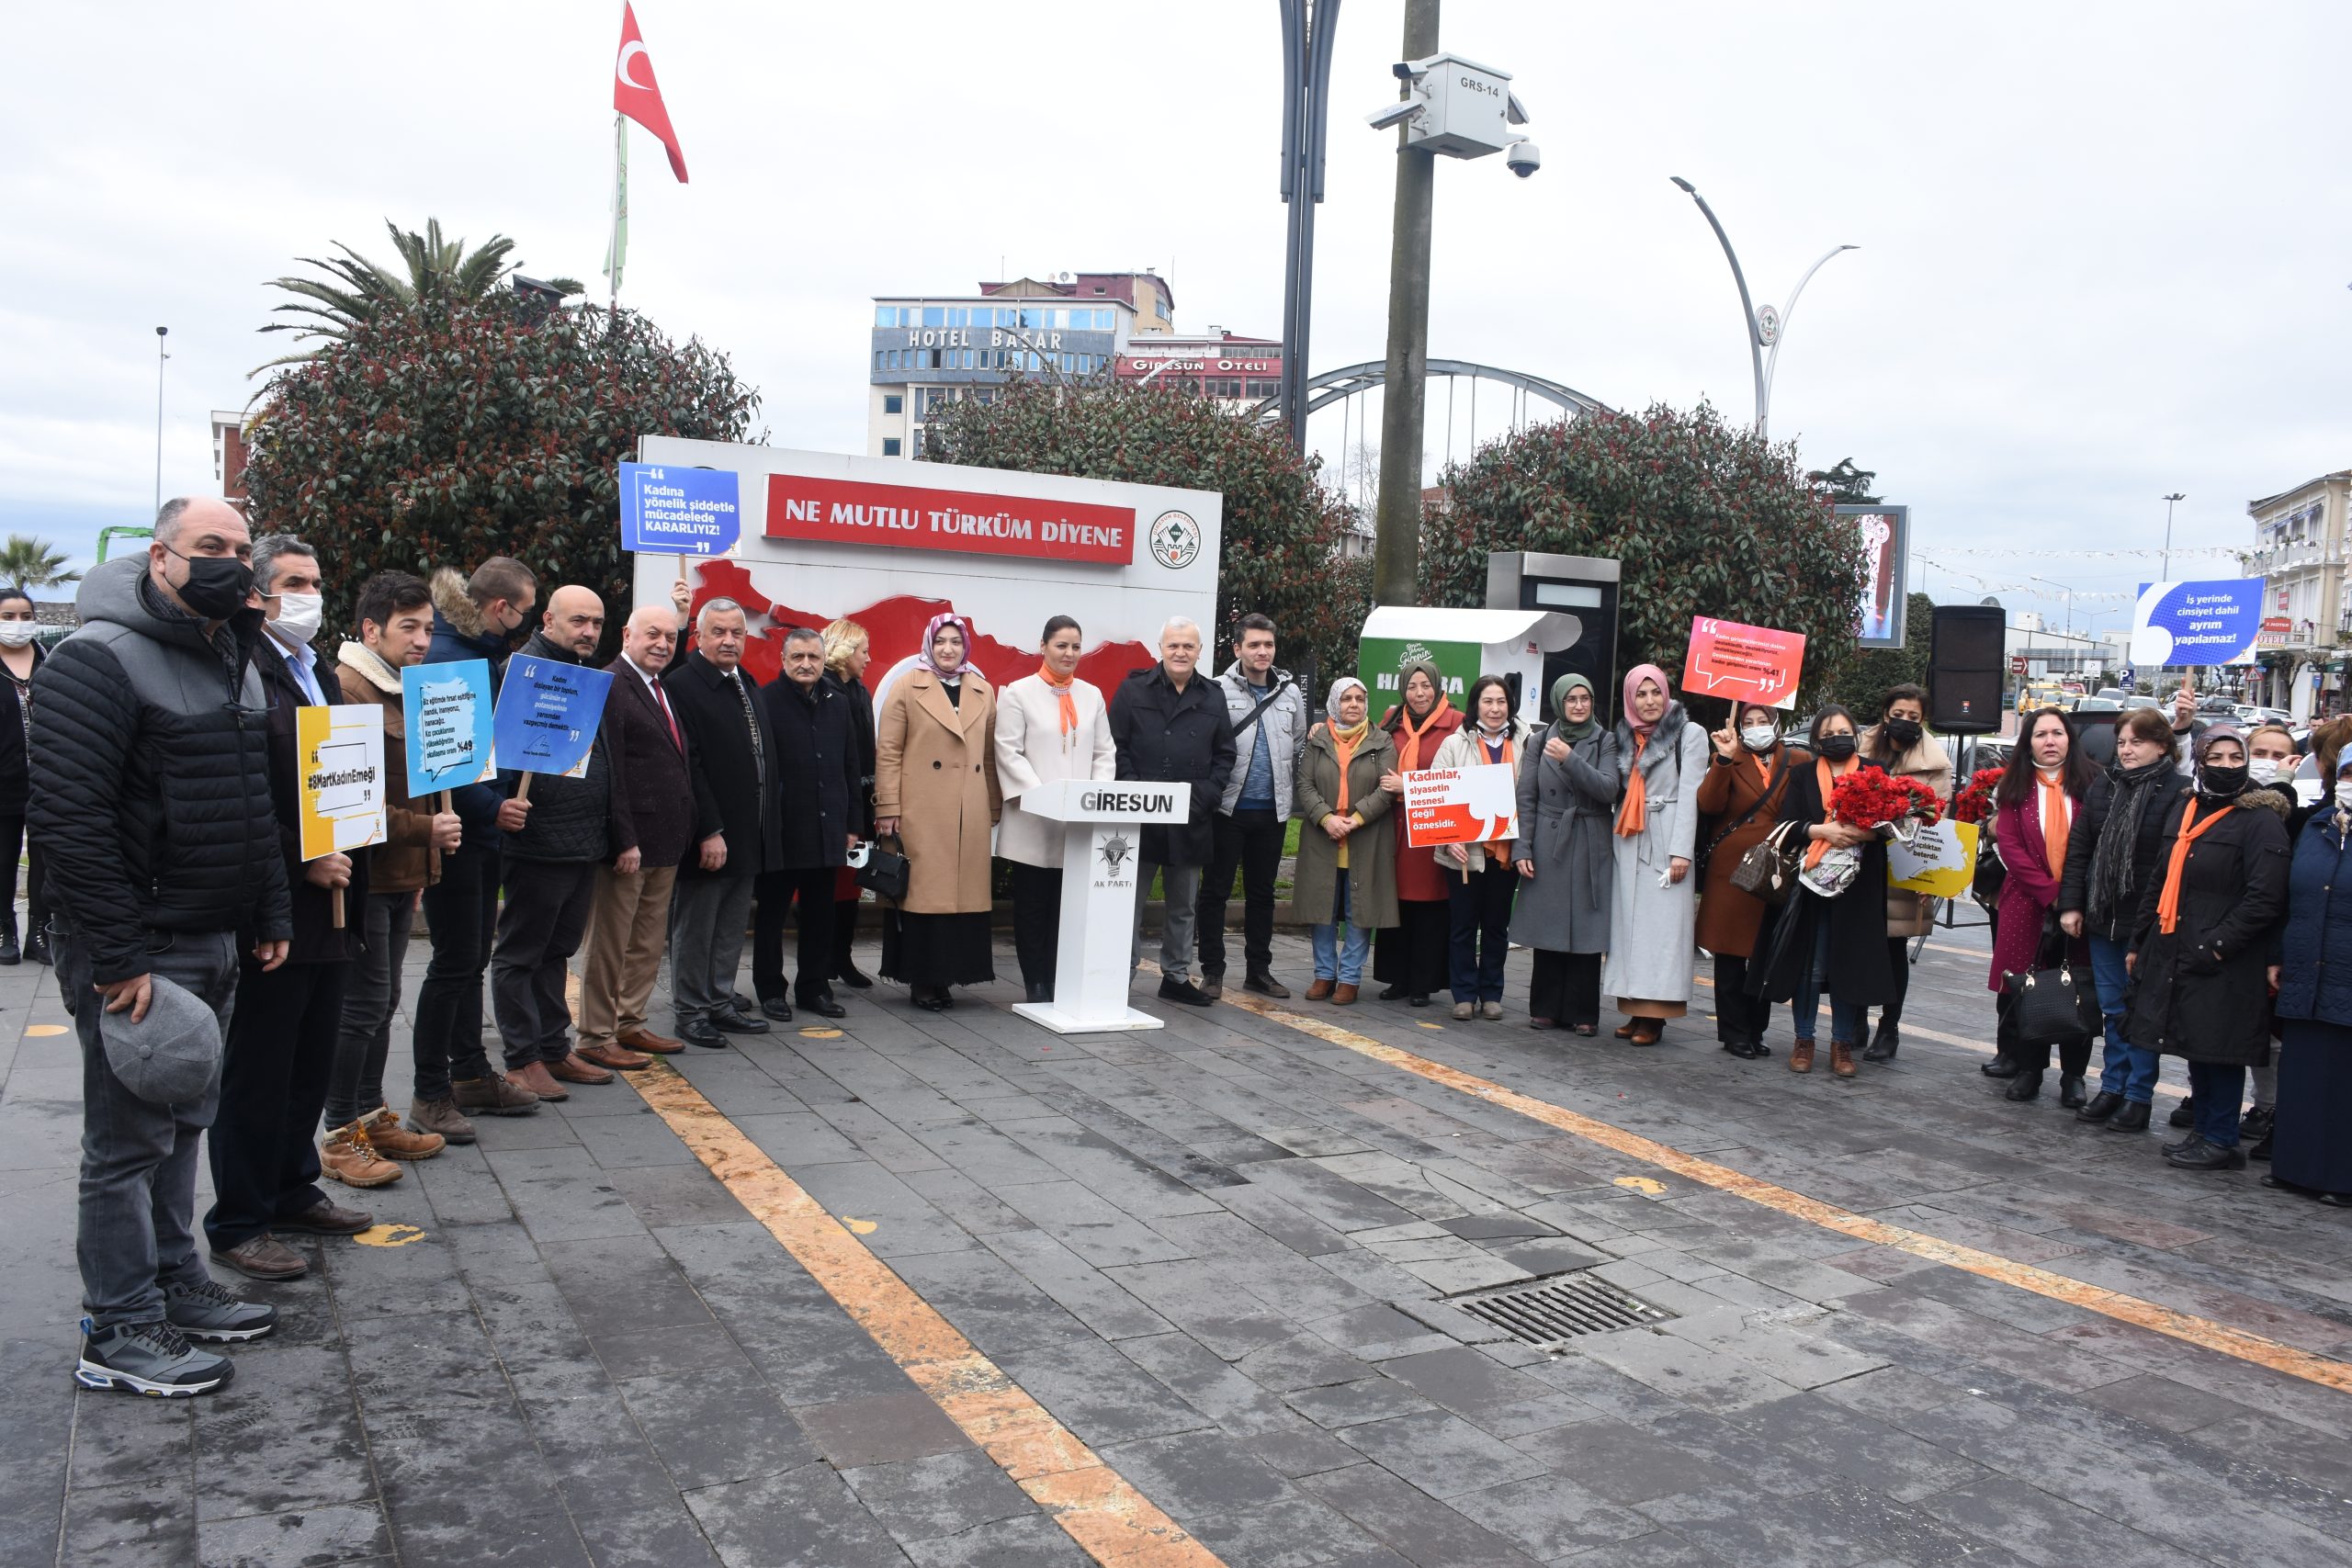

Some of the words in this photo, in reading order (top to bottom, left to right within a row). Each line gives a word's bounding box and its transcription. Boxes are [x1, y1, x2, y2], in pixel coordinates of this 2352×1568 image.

[1460, 76, 1499, 98] GRS-14
[909, 330, 969, 347] HOTEL
[644, 484, 684, 497] Kadına
[644, 497, 687, 509] yönelik
[689, 500, 735, 513] şiddetle
[645, 510, 715, 523] mücadelede
[645, 521, 720, 536] KARARLIYIZ!
[786, 499, 820, 523] NE
[830, 502, 920, 530] MUTLU
[928, 508, 1033, 540] TÜRKÜM
[1041, 518, 1123, 547] DİYENE
[2187, 593, 2195, 604] İş
[2196, 594, 2233, 604] yerinde
[2177, 607, 2212, 616] cinsiyet
[2215, 605, 2239, 615] dahil
[2188, 621, 2222, 631] ayrım
[2175, 634, 2236, 646] yapılamaz!
[1763, 667, 1780, 676] %41
[457, 739, 472, 752] %49
[1408, 769, 1461, 783] Kadınlar,
[1409, 784, 1450, 795] siyasetin
[1080, 788, 1173, 813] GİRESUN
[1410, 795, 1445, 807] nesnesi
[1411, 807, 1435, 818] değil
[1412, 819, 1457, 830] öznesidir.
[1913, 850, 1939, 861] beterdir.
[1093, 880, 1104, 888] AK
